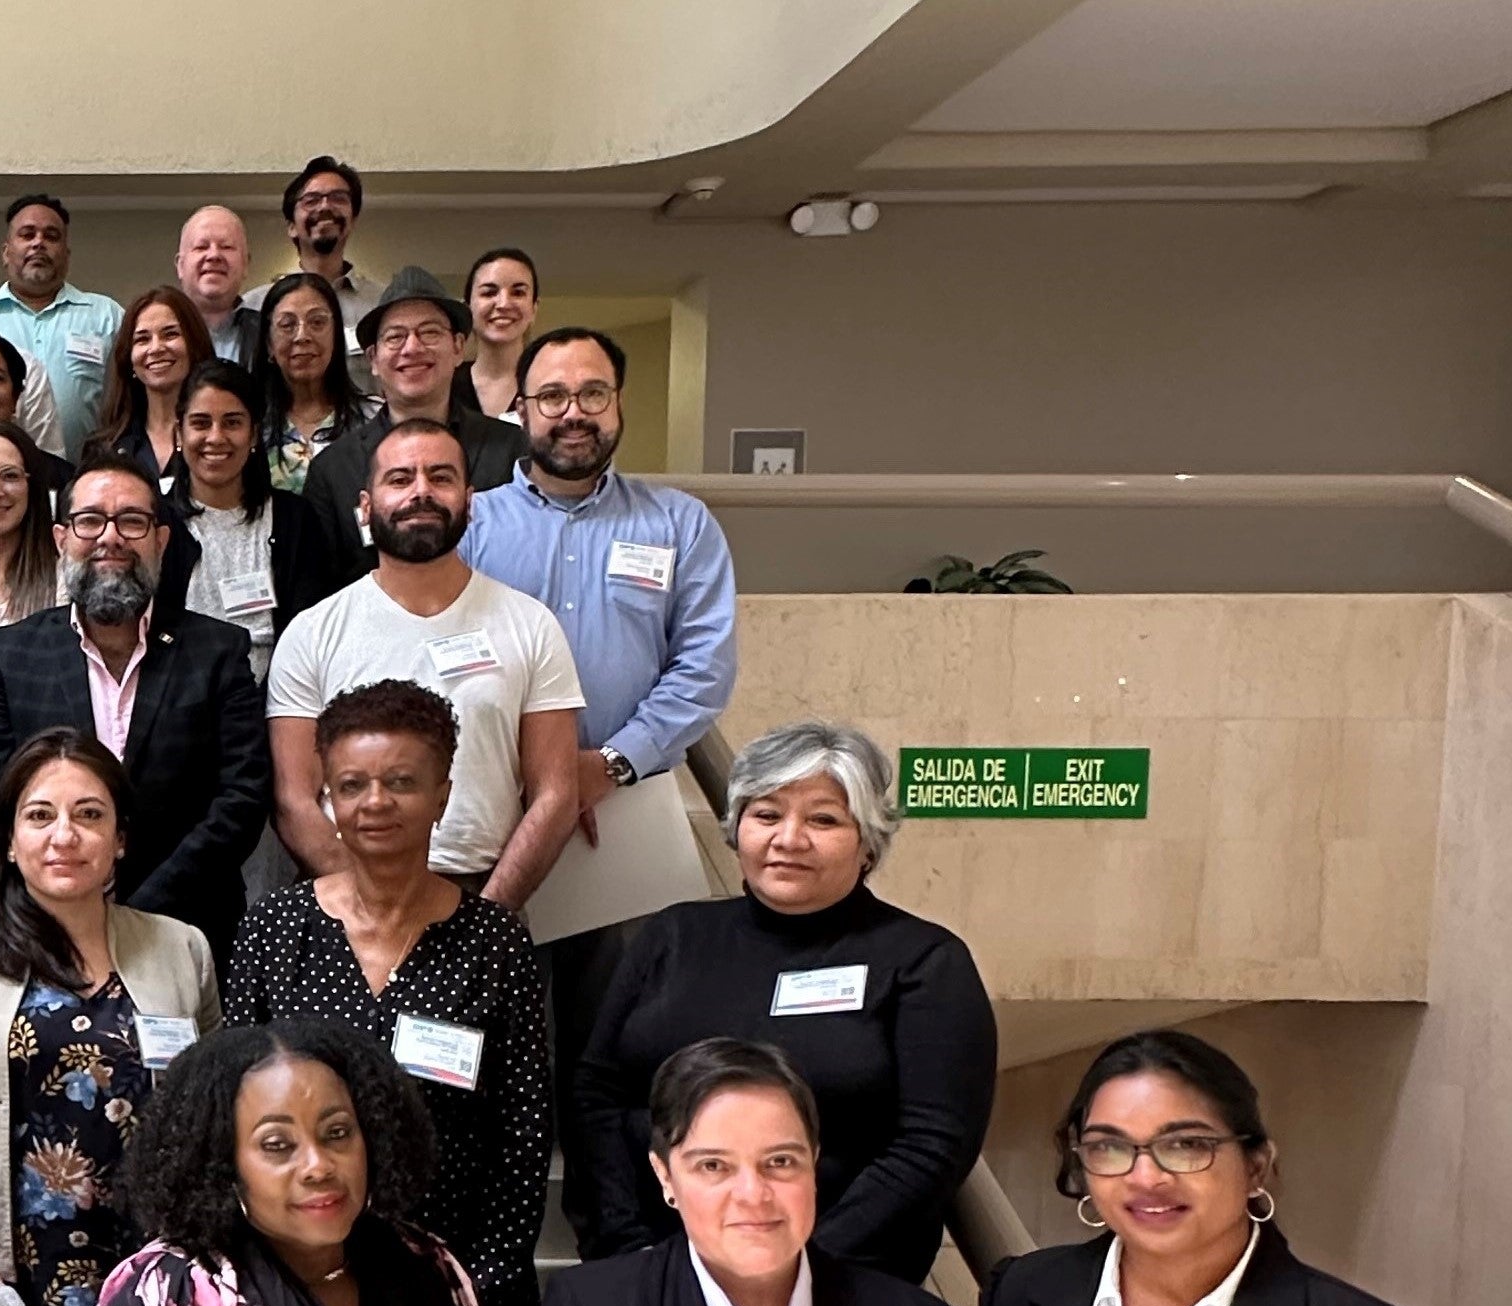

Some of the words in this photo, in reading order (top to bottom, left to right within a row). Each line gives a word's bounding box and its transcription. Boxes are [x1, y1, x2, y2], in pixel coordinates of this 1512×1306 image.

[912, 757, 976, 782] SALIDA
[983, 758, 1006, 781] DE
[1065, 758, 1105, 782] EXIT
[906, 785, 1018, 808] EMERGENCIA
[1032, 783, 1139, 806] EMERGENCY
